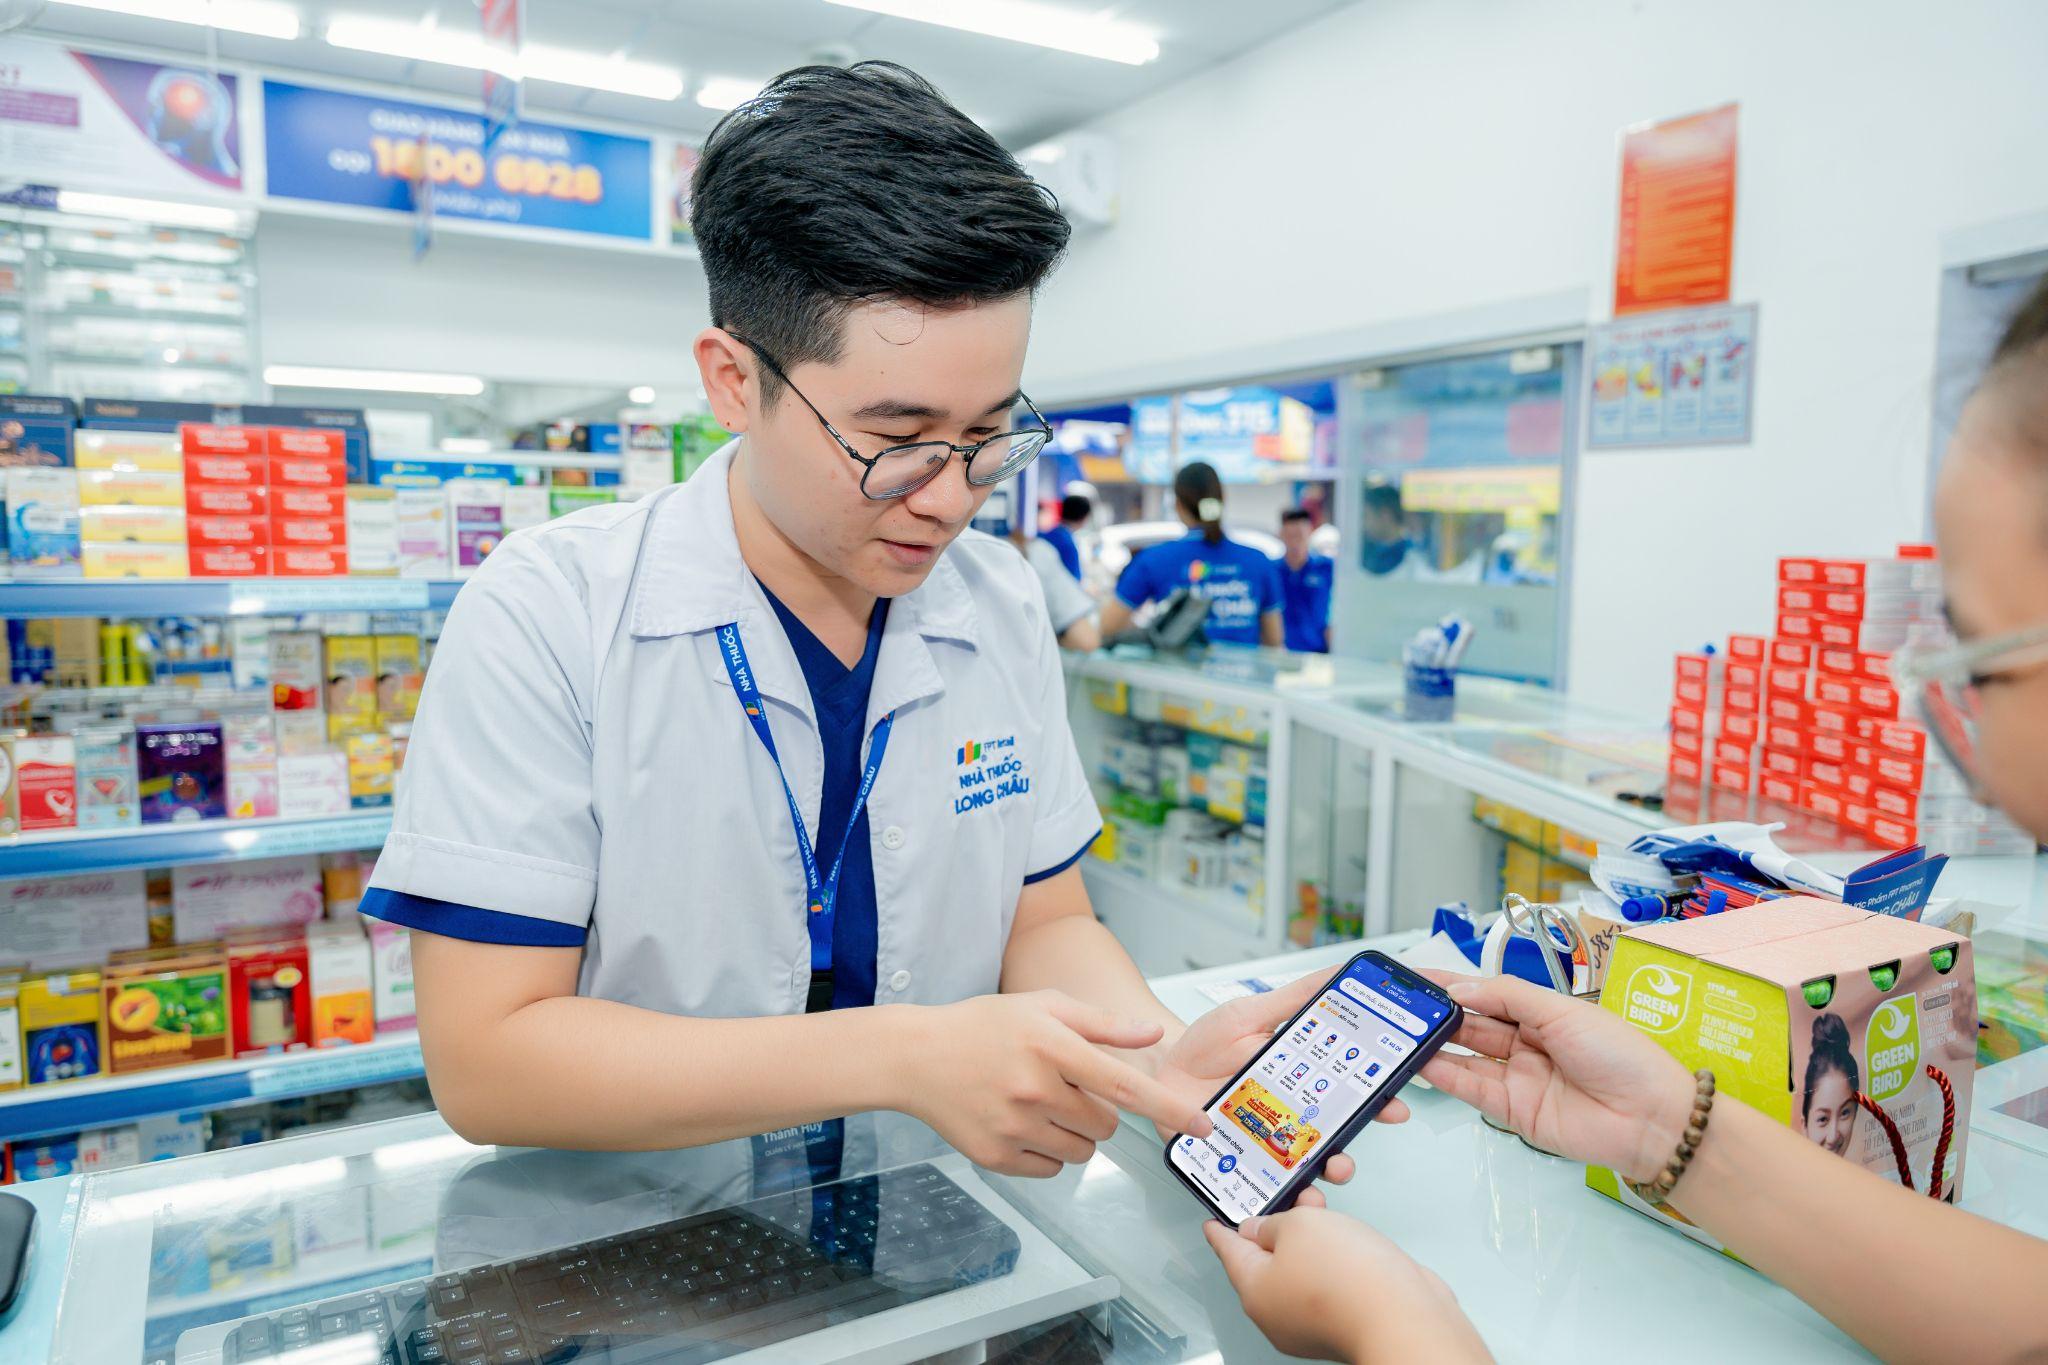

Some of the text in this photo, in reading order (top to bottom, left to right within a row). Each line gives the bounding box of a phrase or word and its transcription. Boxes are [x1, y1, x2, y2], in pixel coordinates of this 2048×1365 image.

[721, 626, 752, 692] NHÀ THUỐC
[959, 753, 1022, 789] NHÀ THUỐC
[955, 773, 1030, 815] LONG CHÂU
[1888, 888, 1900, 900] FPT
[1890, 890, 1921, 915] CHÂU
[1628, 1005, 1663, 1028] BIRD
[1631, 990, 1681, 1018] GREEN
[1872, 1042, 1915, 1072] GREEN
[1872, 1069, 1903, 1095] BIRD
